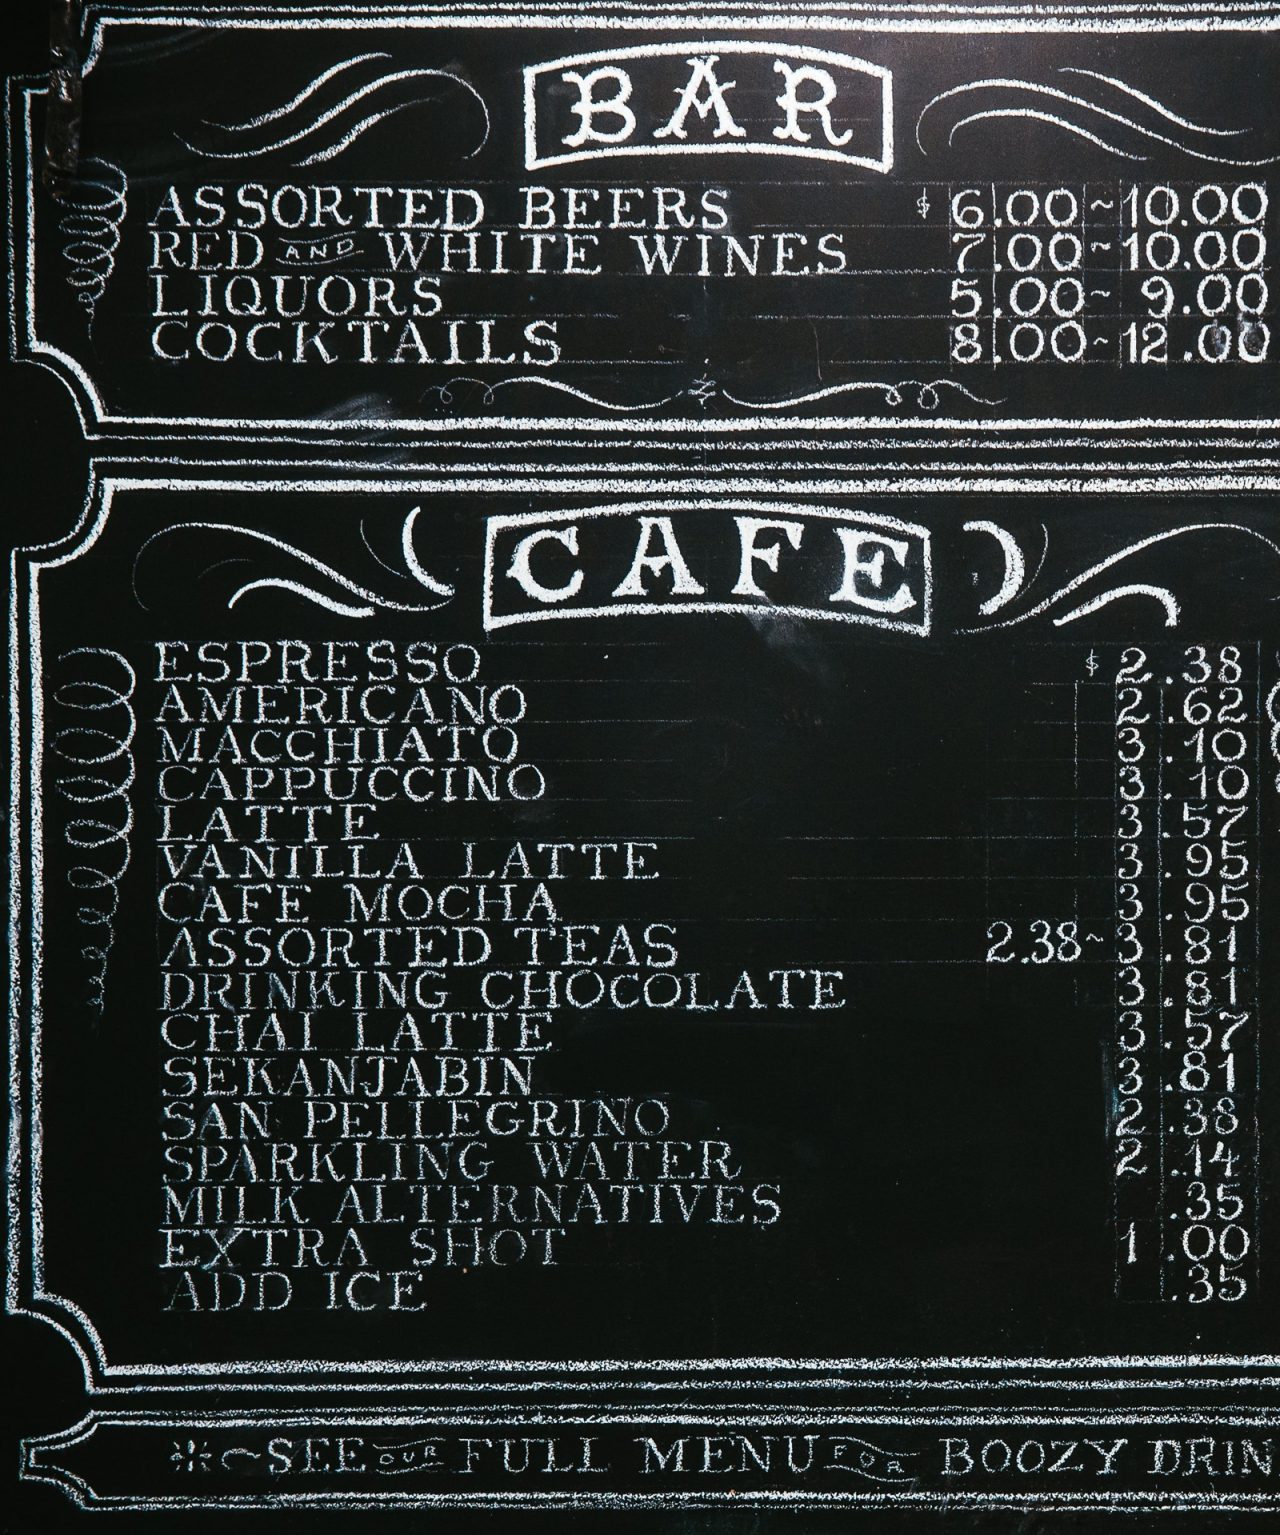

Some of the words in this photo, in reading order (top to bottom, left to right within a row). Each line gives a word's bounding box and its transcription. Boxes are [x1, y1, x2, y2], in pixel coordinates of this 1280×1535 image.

[561, 55, 853, 148] BAR
[149, 185, 486, 230] ASSORTED
[518, 186, 729, 230] BEERS
[916, 187, 931, 219] $
[149, 231, 264, 270] RED
[285, 238, 355, 259] AND
[379, 232, 602, 275] WHITE
[637, 233, 848, 275] WINES
[149, 275, 443, 317] LIQUORS
[151, 320, 562, 366] COCKTAILS
[506, 515, 915, 613] CAFE
[155, 641, 481, 683] ESPRESSO
[1085, 649, 1099, 676] $
[1116, 646, 1243, 684] 2.38
[155, 684, 527, 724] AMERICANO
[1116, 687, 1248, 725] 2.62
[156, 725, 518, 764] MACCHIATO
[1117, 727, 1247, 763] 3.10
[157, 764, 546, 802] CAPPUCCINO
[1118, 765, 1249, 800] 3.10
[157, 803, 380, 842] LATTE
[1117, 802, 1248, 839] 3.57
[157, 844, 424, 880] VANILLA
[459, 841, 660, 880] LATTE
[1117, 840, 1249, 880] 3.95
[158, 883, 309, 923] CAFE
[343, 882, 562, 924] MOCHA
[1117, 881, 1249, 922] 3.95
[160, 925, 490, 968] ASSORTED
[513, 922, 678, 967] TEAS
[159, 970, 449, 1011] DRINKING
[481, 969, 847, 1011] CHOCOLATE
[1117, 966, 1238, 1006] 3.81
[161, 1012, 318, 1052] CHAI
[356, 1011, 553, 1053] LATTE
[1117, 1009, 1249, 1052] 3.57
[161, 1056, 533, 1098] SEKANJABIN
[1117, 1052, 1236, 1094] 3.81
[161, 1101, 271, 1140] SAN
[303, 1098, 670, 1139] PELLEGRINO
[1116, 1097, 1238, 1135] 2.38
[162, 1142, 495, 1182] SPARKLING
[531, 1140, 742, 1181] WATER
[162, 1185, 309, 1225] MILK
[335, 1183, 781, 1225] ALTERNATIVES
[158, 1228, 370, 1269] EXTRA
[411, 1228, 567, 1267] SHOT
[1120, 1222, 1250, 1264] 1.00
[162, 1272, 292, 1311] ADD
[325, 1271, 427, 1312] ICE
[267, 1437, 368, 1475] SEE
[378, 1445, 439, 1464] OUR
[457, 1437, 609, 1474] FULL
[639, 1434, 821, 1474] MENU
[832, 1445, 902, 1472] FOR
[939, 1438, 1129, 1476] BOOZY
